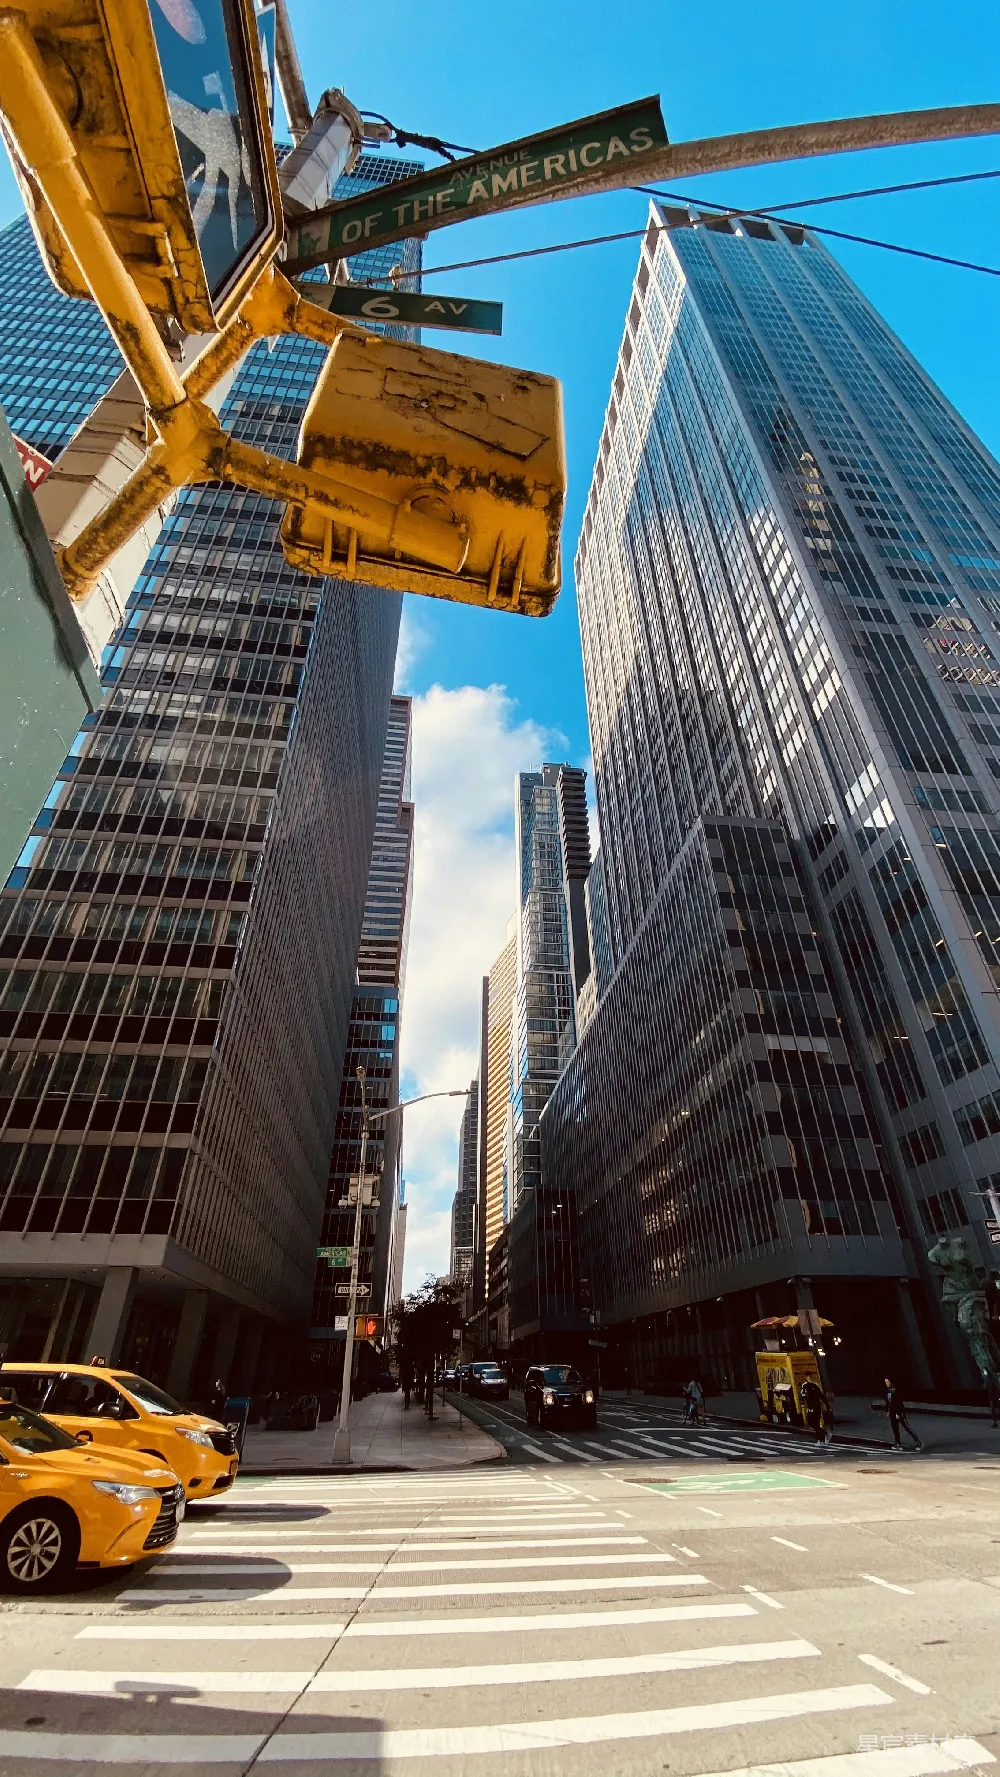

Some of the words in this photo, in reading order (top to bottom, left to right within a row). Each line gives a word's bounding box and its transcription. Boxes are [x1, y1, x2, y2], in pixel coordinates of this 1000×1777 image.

[449, 147, 532, 187] AVENUE
[341, 211, 383, 244] OF
[392, 188, 455, 228] THE
[466, 127, 654, 205] AMERICAS
[361, 296, 400, 318] 6
[424, 300, 468, 316] AV
[331, 1258, 336, 1266] 6
